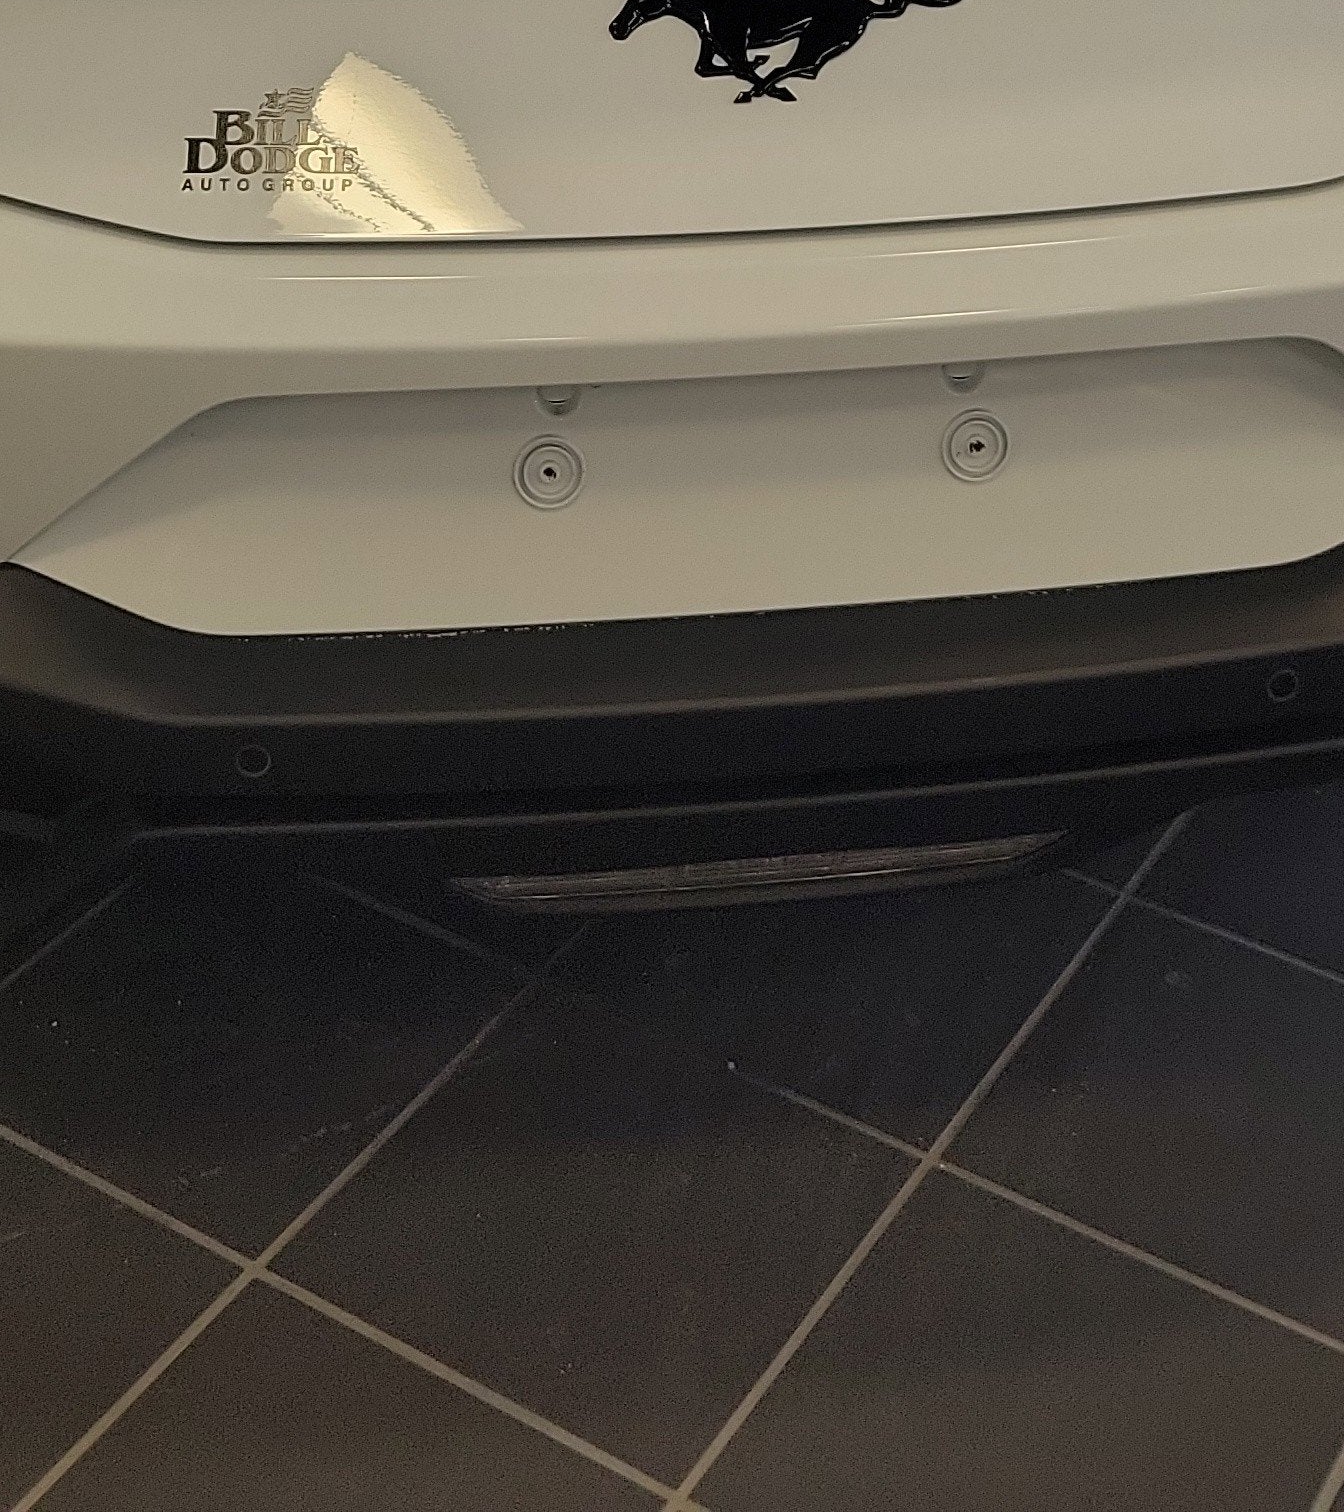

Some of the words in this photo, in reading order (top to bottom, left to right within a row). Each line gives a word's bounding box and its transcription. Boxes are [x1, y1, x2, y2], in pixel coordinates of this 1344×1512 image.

[213, 109, 323, 146] BILL
[182, 137, 360, 175] DODGE
[181, 177, 251, 192] AUTO
[262, 177, 354, 192] GROUP
